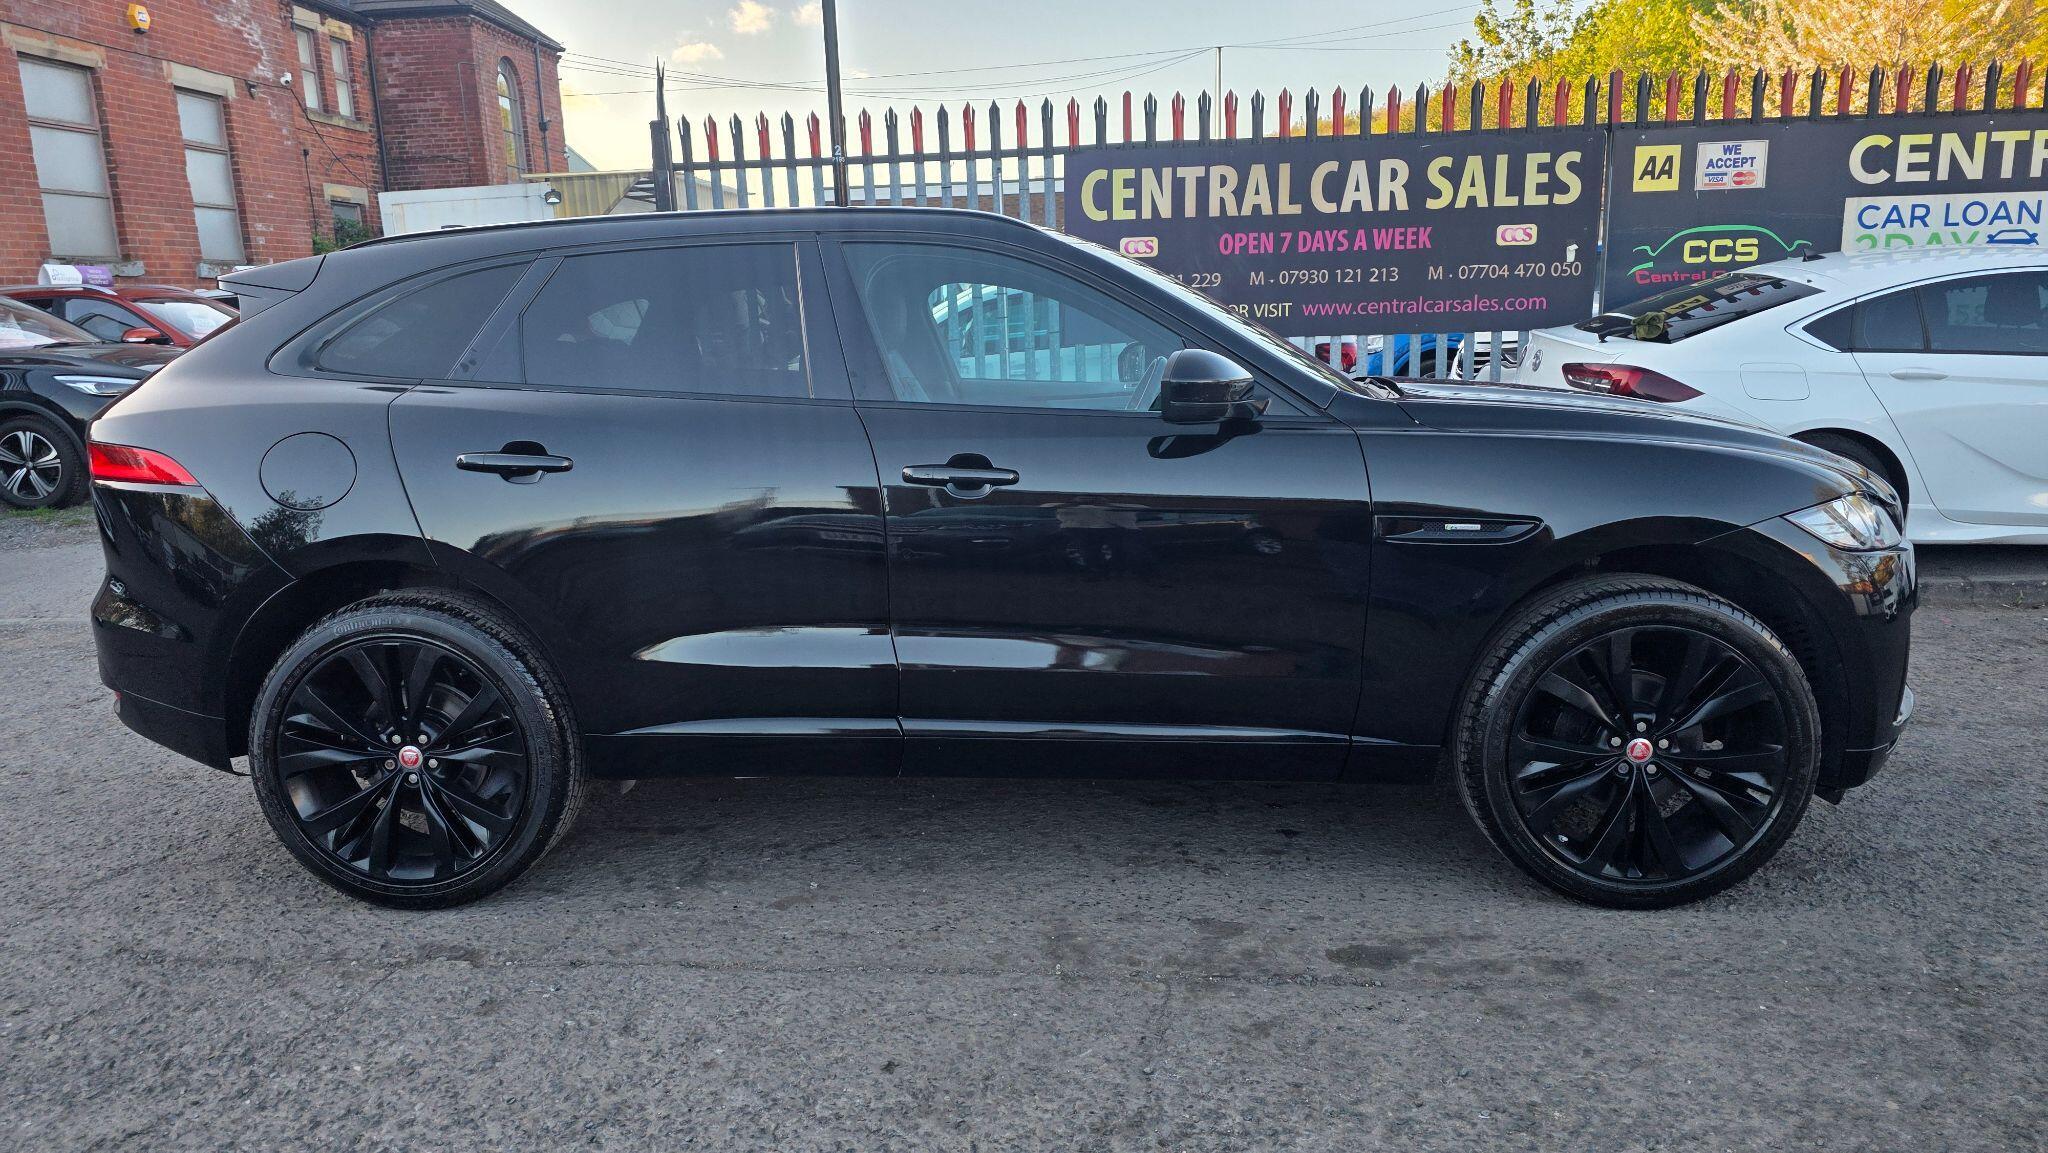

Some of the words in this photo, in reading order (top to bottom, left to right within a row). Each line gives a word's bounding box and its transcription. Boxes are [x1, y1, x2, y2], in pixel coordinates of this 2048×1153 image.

[1723, 144, 1742, 155] WE
[1638, 154, 1673, 180] AA
[1706, 157, 1756, 169] ACCEPT
[1081, 163, 1302, 221] CENTRAL
[1310, 158, 1409, 213] CAR
[1426, 151, 1582, 210] SALES
[1857, 204, 1931, 229] CAR
[1943, 200, 2042, 227] LOAN
[1219, 231, 1274, 255] OPEN
[1280, 232, 1292, 253] 7
[1297, 229, 1349, 252] DAYS
[1353, 229, 1367, 251] A
[1372, 226, 1433, 250] WEEK
[1683, 237, 1759, 264] CCS
[1190, 272, 1222, 288] 229
[1279, 269, 1329, 285] 07930
[1335, 268, 1362, 283] 121
[1368, 267, 1399, 282] 213
[1458, 264, 1510, 280] 07704
[1514, 263, 1546, 278] 470
[1550, 261, 1582, 276] 050
[1635, 270, 1707, 285] Central
[1253, 303, 1293, 318] VISIT
[1302, 294, 1547, 317] www.centralcarsales.com
